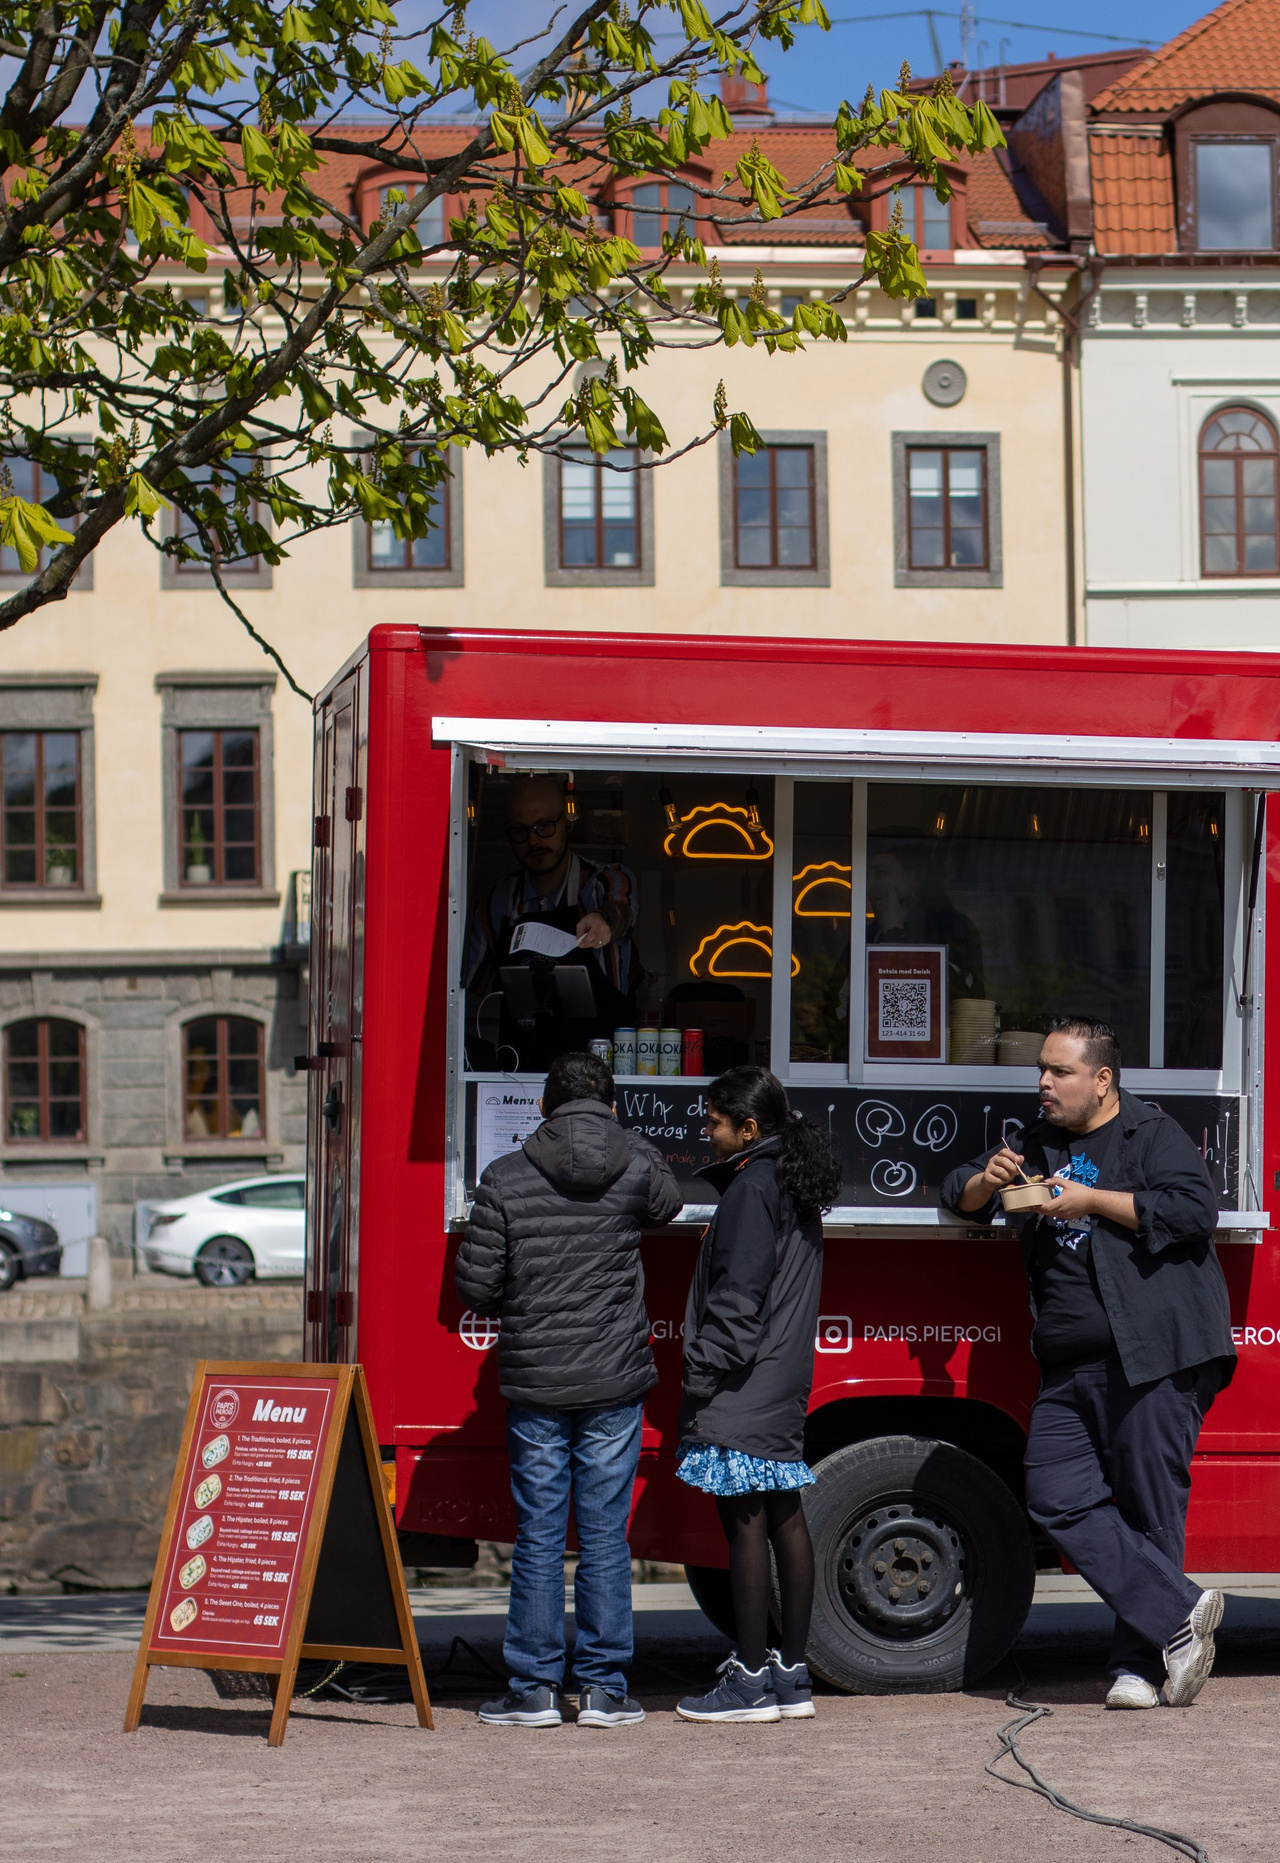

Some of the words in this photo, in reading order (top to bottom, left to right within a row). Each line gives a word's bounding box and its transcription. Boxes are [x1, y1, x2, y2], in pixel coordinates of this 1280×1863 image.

[660, 1044, 682, 1054] LOK
[503, 1096, 535, 1105] Menu
[624, 1091, 674, 1124] Why
[665, 1149, 696, 1165] make
[863, 1325, 1002, 1343] PAPIS.PIEROGI
[252, 1399, 307, 1423] Menu
[251, 1435, 275, 1444] Traditional,
[287, 1449, 298, 1459] 115
[298, 1450, 314, 1460] SEK
[244, 1475, 268, 1484] Traditional,
[278, 1490, 290, 1500] 115
[290, 1491, 306, 1501] SEK
[236, 1516, 253, 1524] Hipster,
[271, 1530, 282, 1541] 115
[282, 1531, 299, 1542] SEK
[227, 1556, 245, 1564] Hipster,
[263, 1571, 274, 1582] 115
[274, 1572, 290, 1583] SEK
[210, 1598, 218, 1606] The
[219, 1599, 232, 1607] Sweet
[253, 1614, 264, 1625] 65
[263, 1615, 279, 1626] SEK
